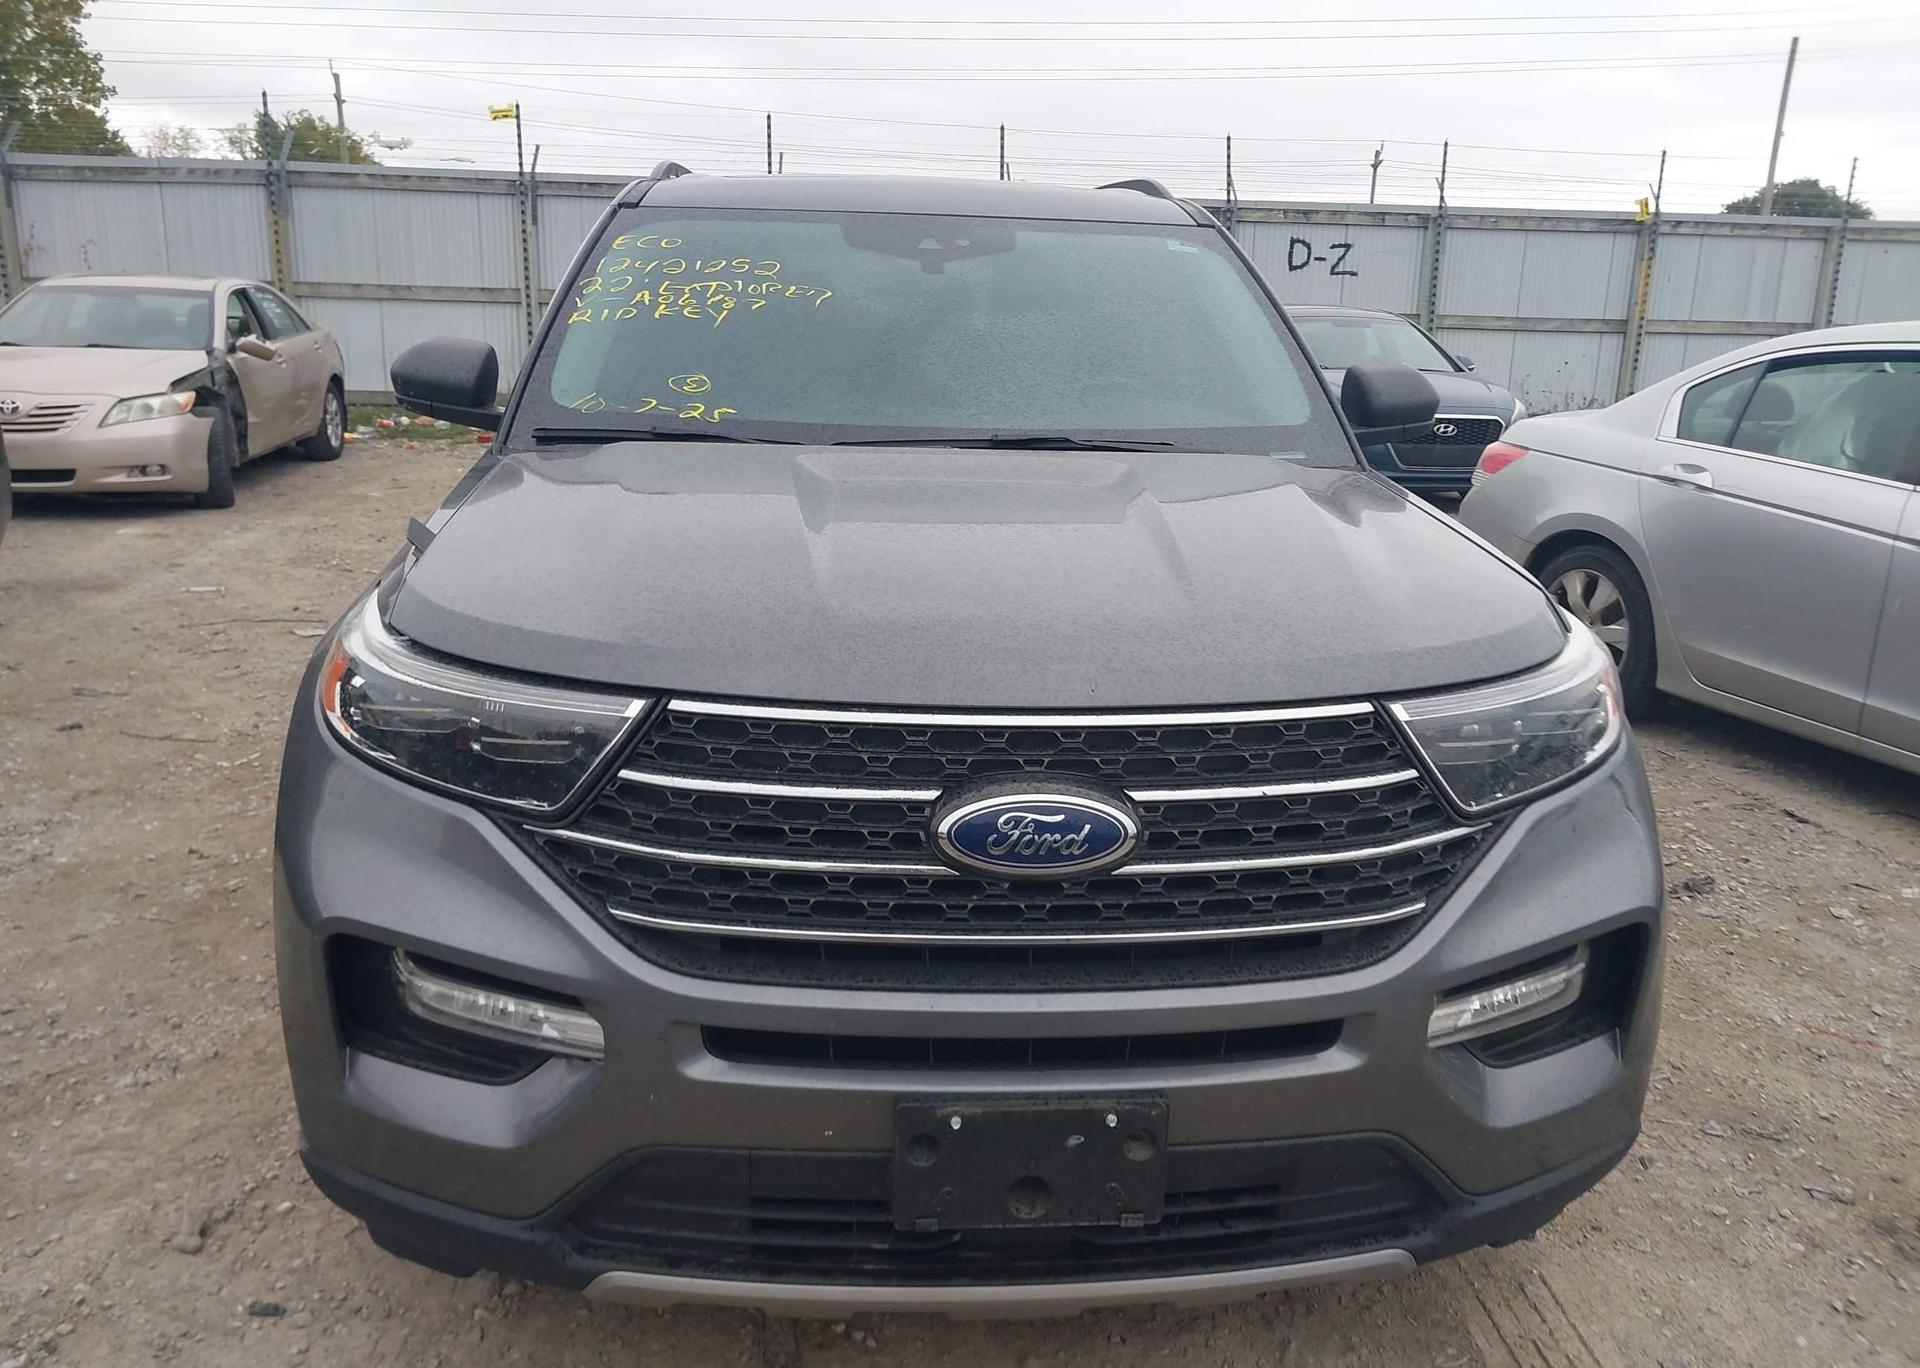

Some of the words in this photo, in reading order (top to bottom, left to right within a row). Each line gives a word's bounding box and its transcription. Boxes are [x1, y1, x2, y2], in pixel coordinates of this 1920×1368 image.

[611, 235, 682, 249] ECO
[1287, 236, 1359, 276] D-Z
[654, 304, 728, 328] KEY
[986, 811, 1092, 856] Ford
